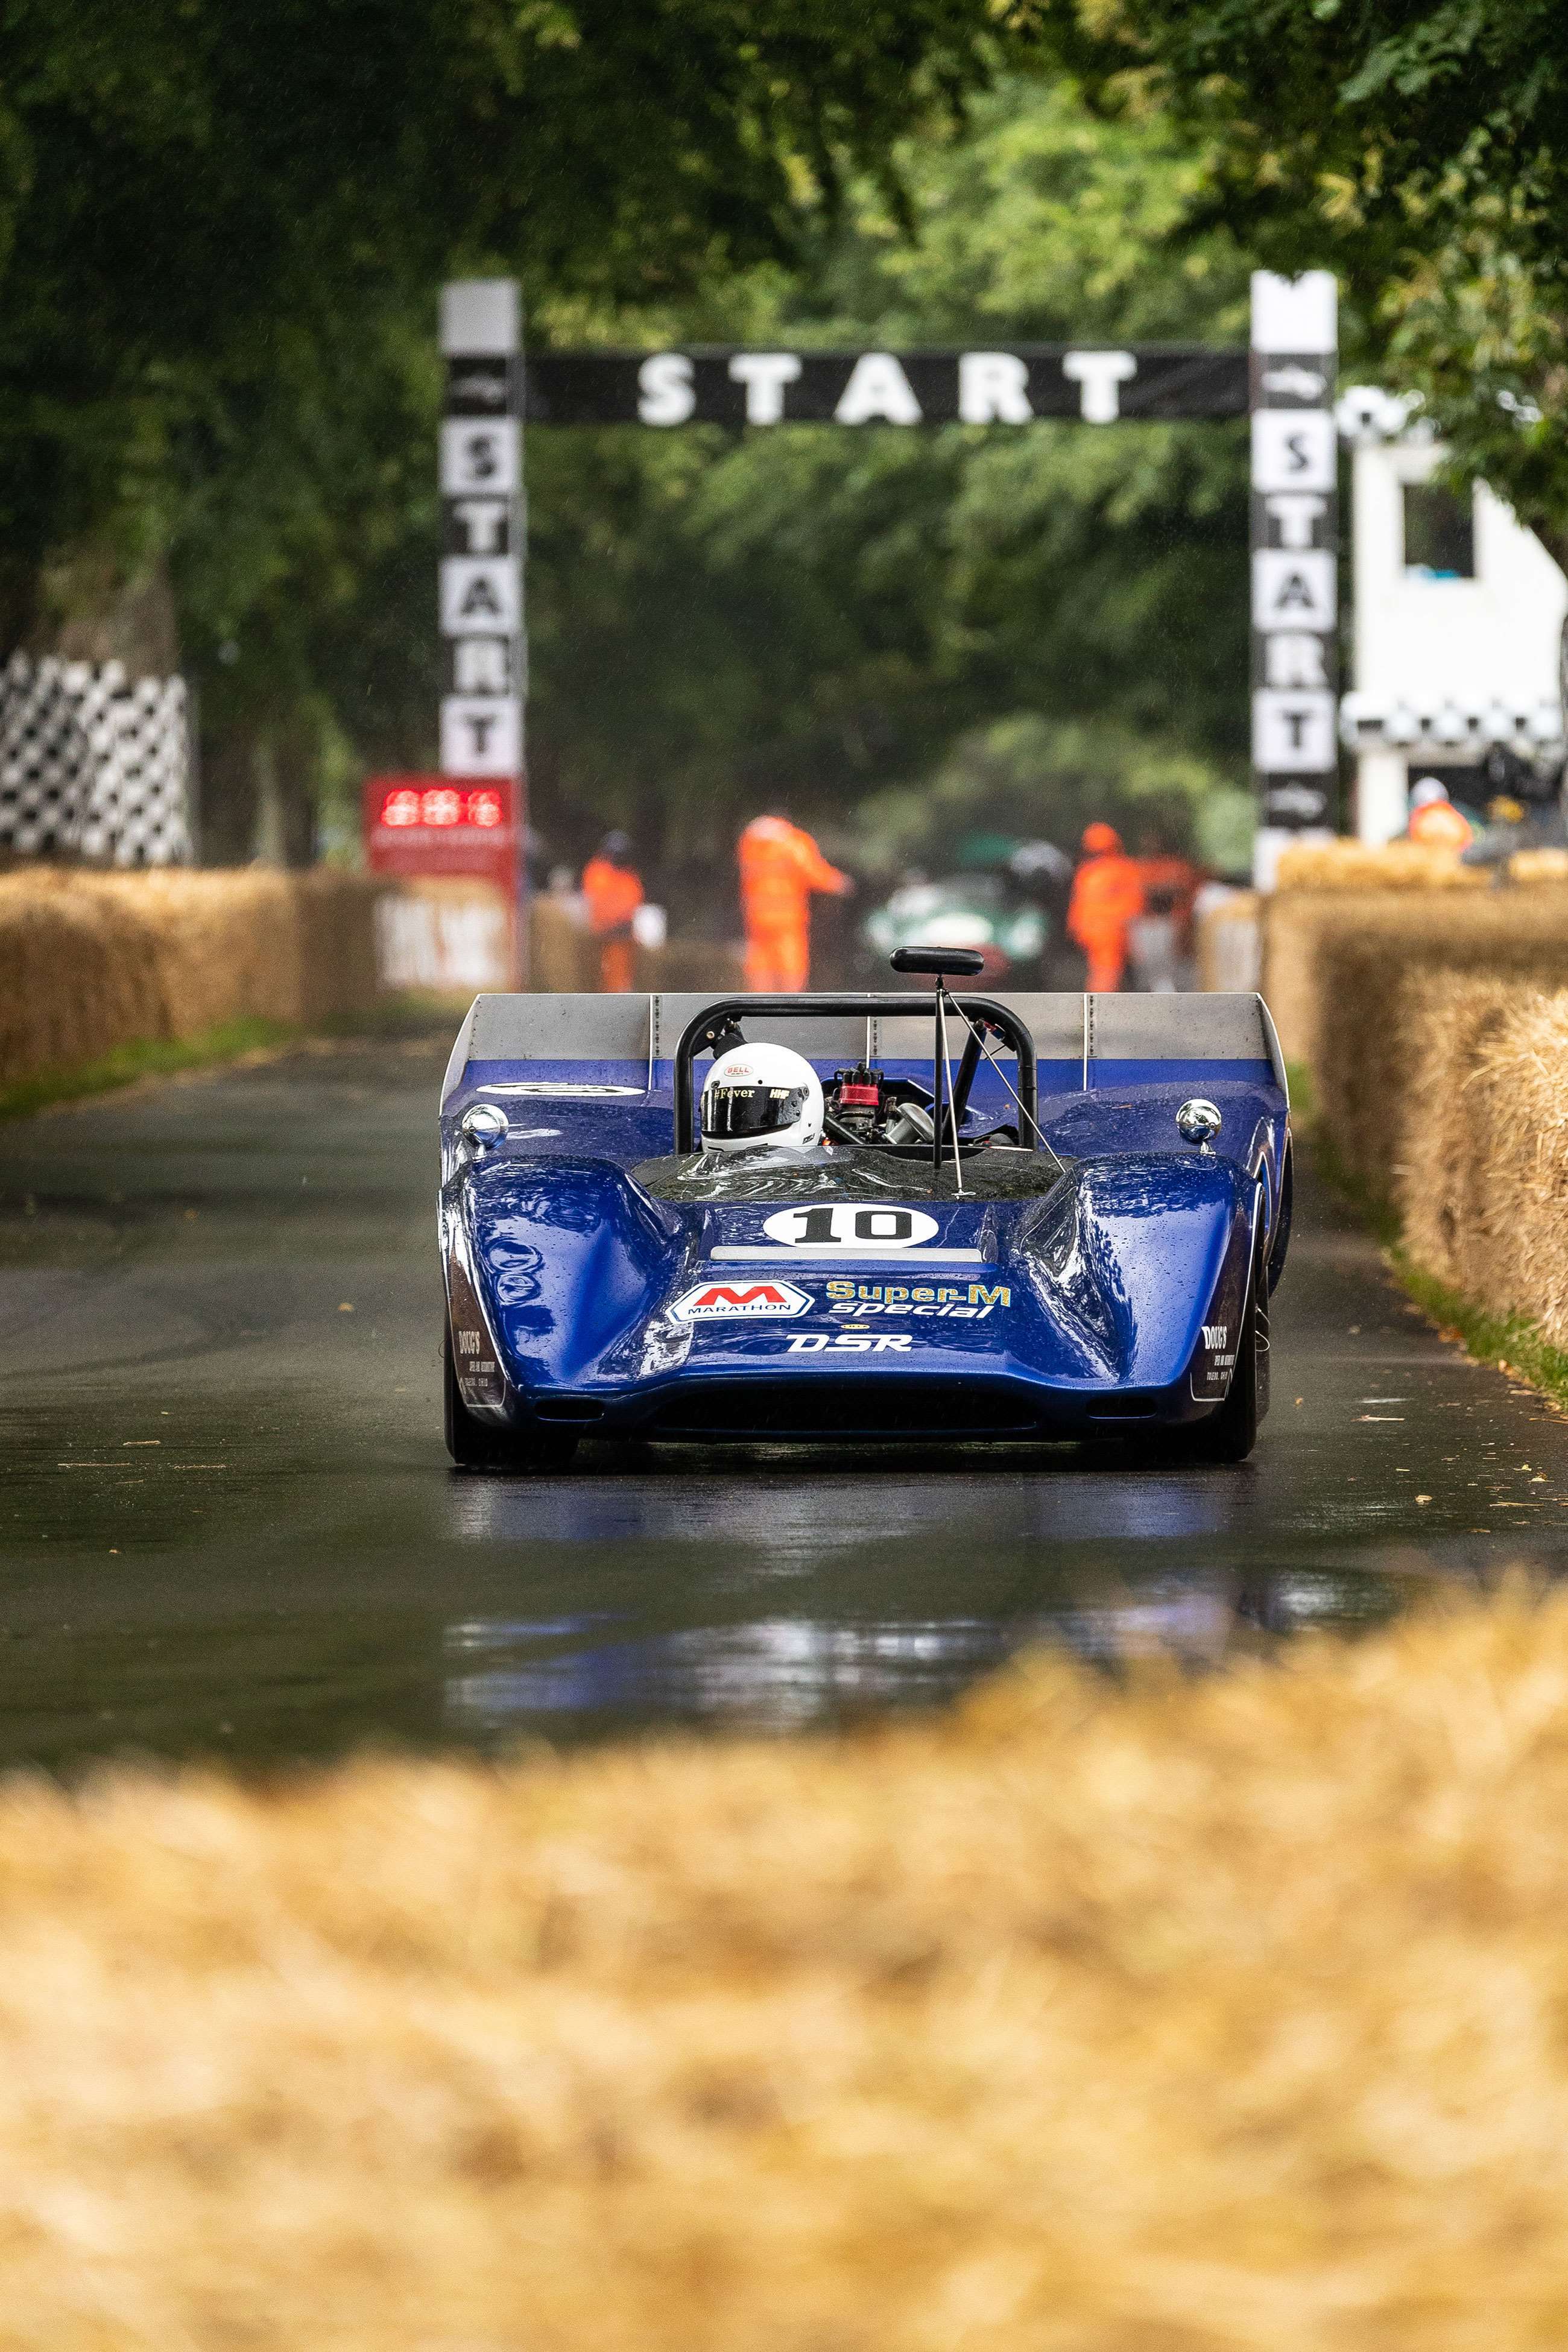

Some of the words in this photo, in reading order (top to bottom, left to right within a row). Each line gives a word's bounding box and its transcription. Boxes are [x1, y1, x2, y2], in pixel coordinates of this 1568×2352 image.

[637, 352, 1138, 426] START
[1265, 432, 1327, 750] START
[714, 1088, 755, 1101] #Fever
[793, 1207, 912, 1243] 10
[826, 1280, 1011, 1307] Super-M
[688, 1304, 791, 1315] MARATHON
[785, 1334, 914, 1353] DSR
